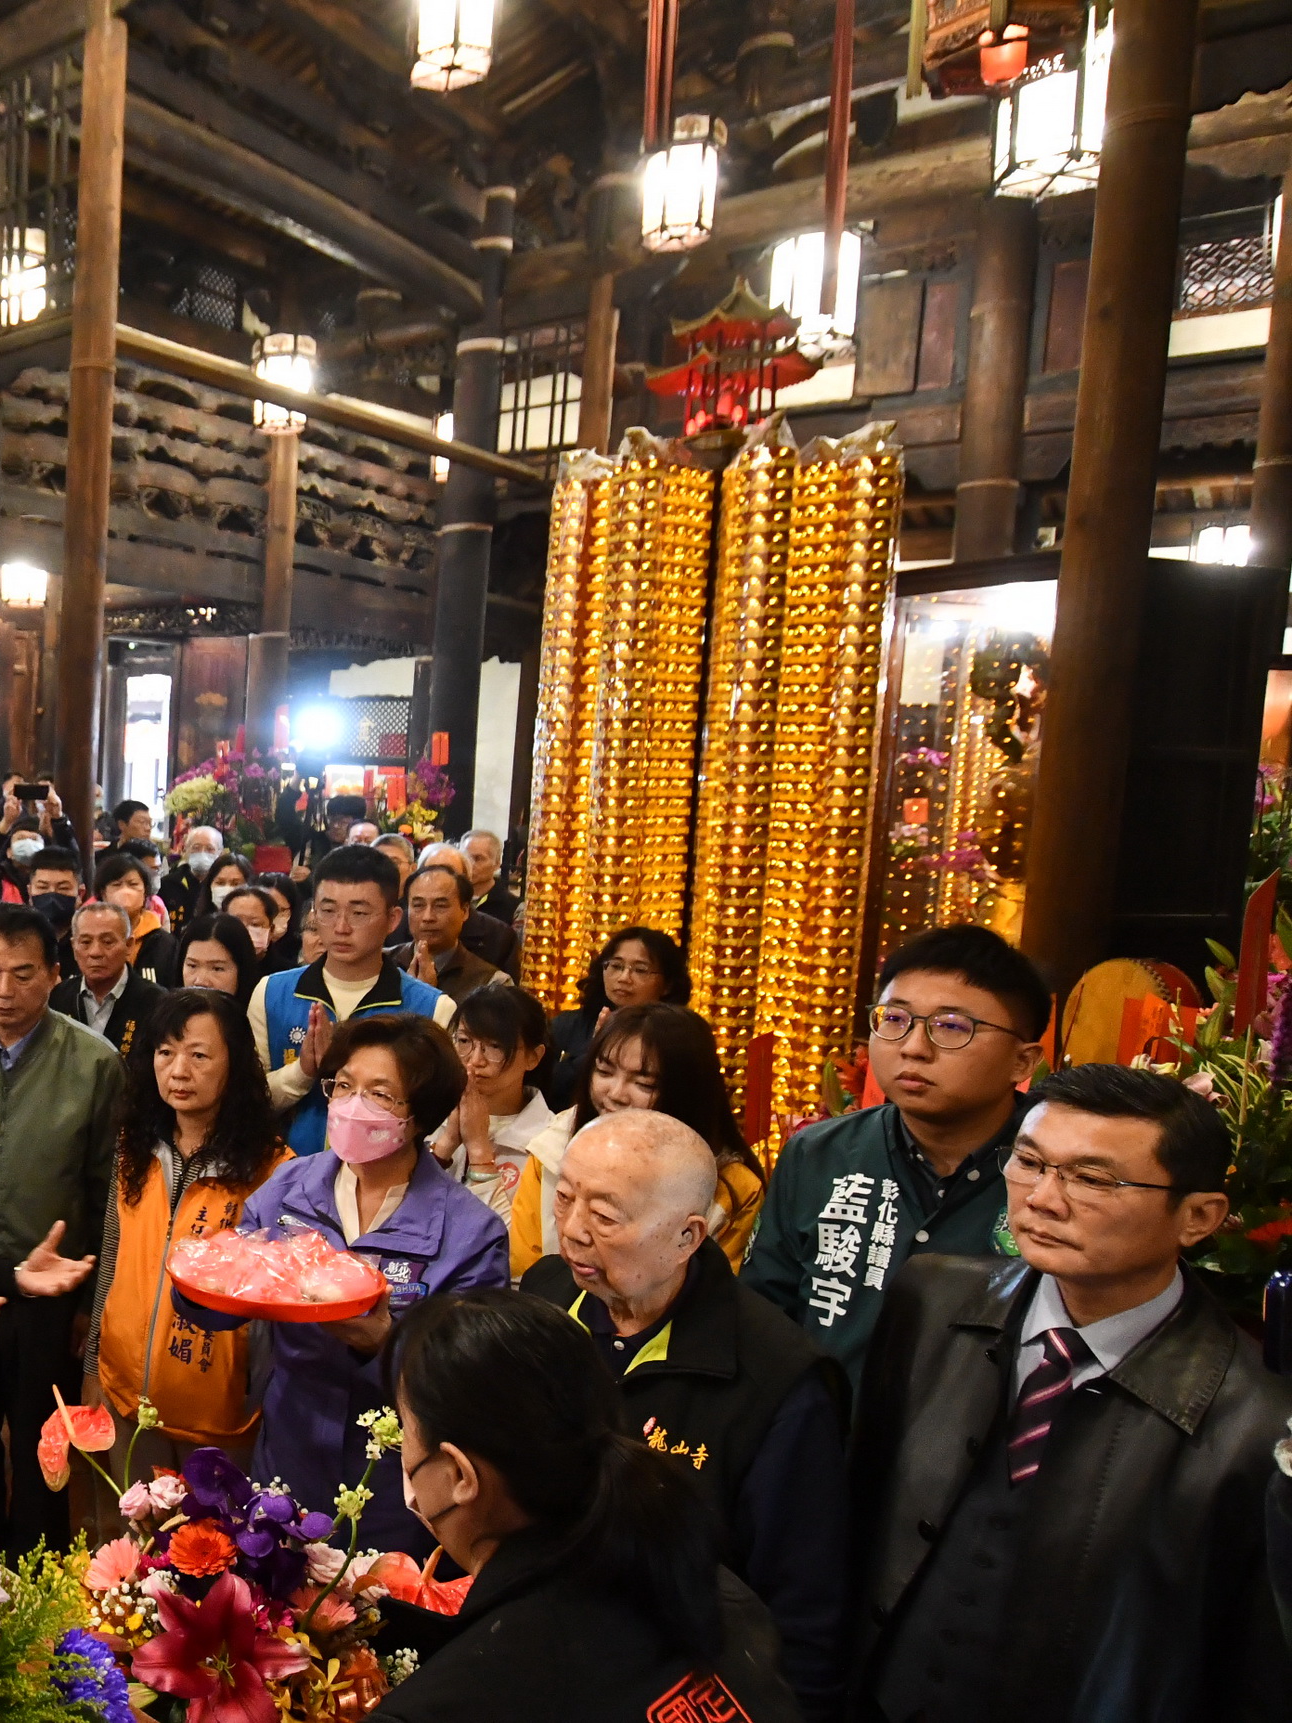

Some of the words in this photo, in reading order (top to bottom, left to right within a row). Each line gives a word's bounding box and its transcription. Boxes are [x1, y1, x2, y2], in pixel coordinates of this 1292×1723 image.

[809, 1173, 875, 1327] 藍駿宇
[863, 1178, 900, 1291] 彰化縣議員
[647, 1426, 710, 1471] 龍山寺
